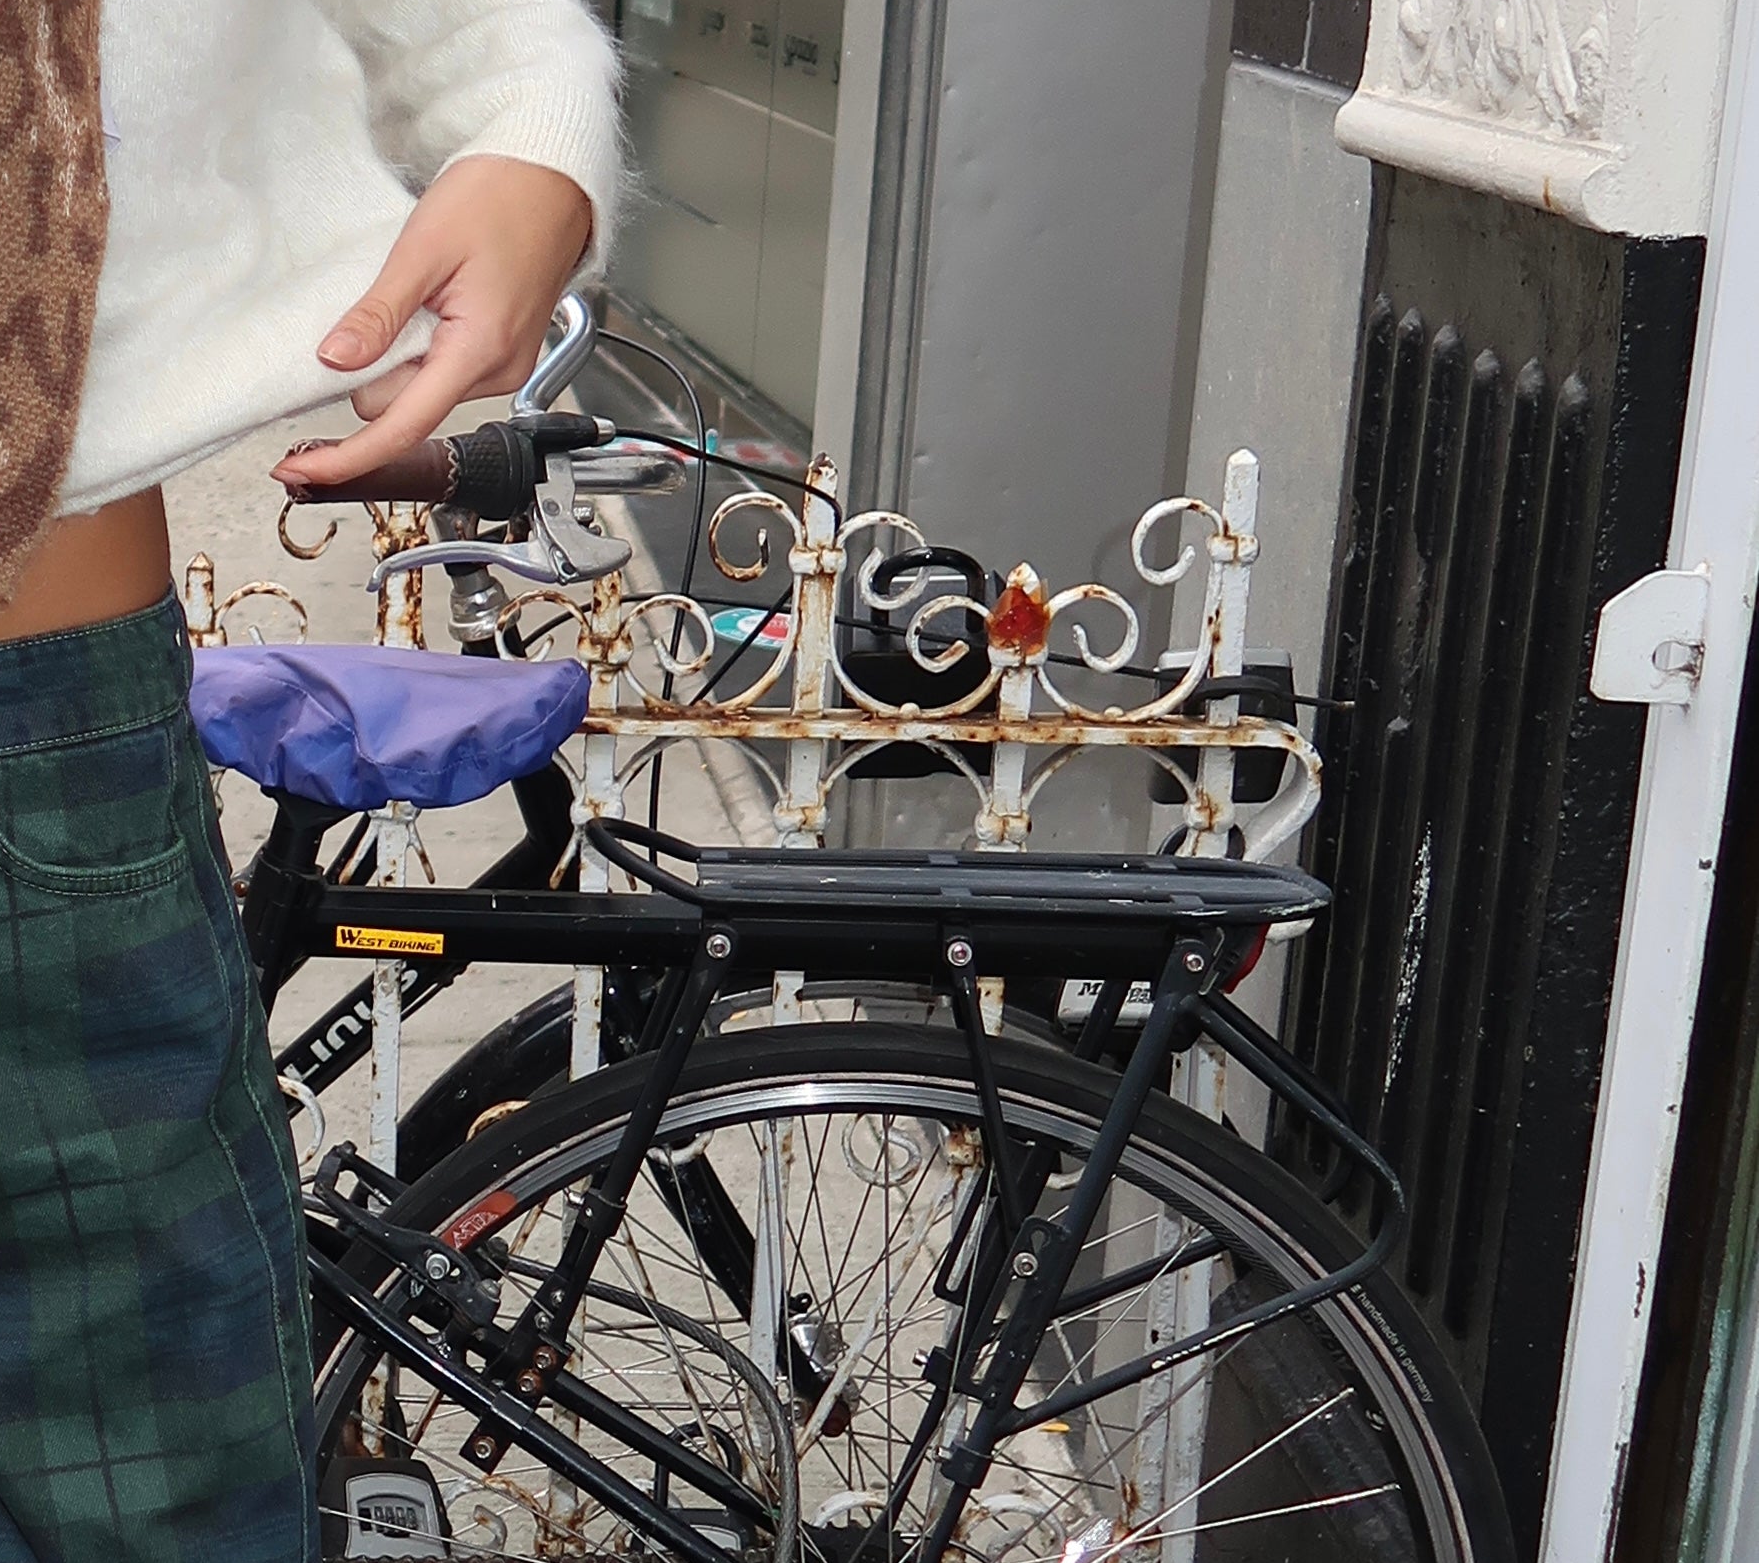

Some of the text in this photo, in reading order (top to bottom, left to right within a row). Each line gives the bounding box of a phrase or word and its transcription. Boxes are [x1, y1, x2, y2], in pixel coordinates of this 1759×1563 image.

[388, 938, 436, 951] BIKING
[1357, 1291, 1434, 1403] handmade in germany
